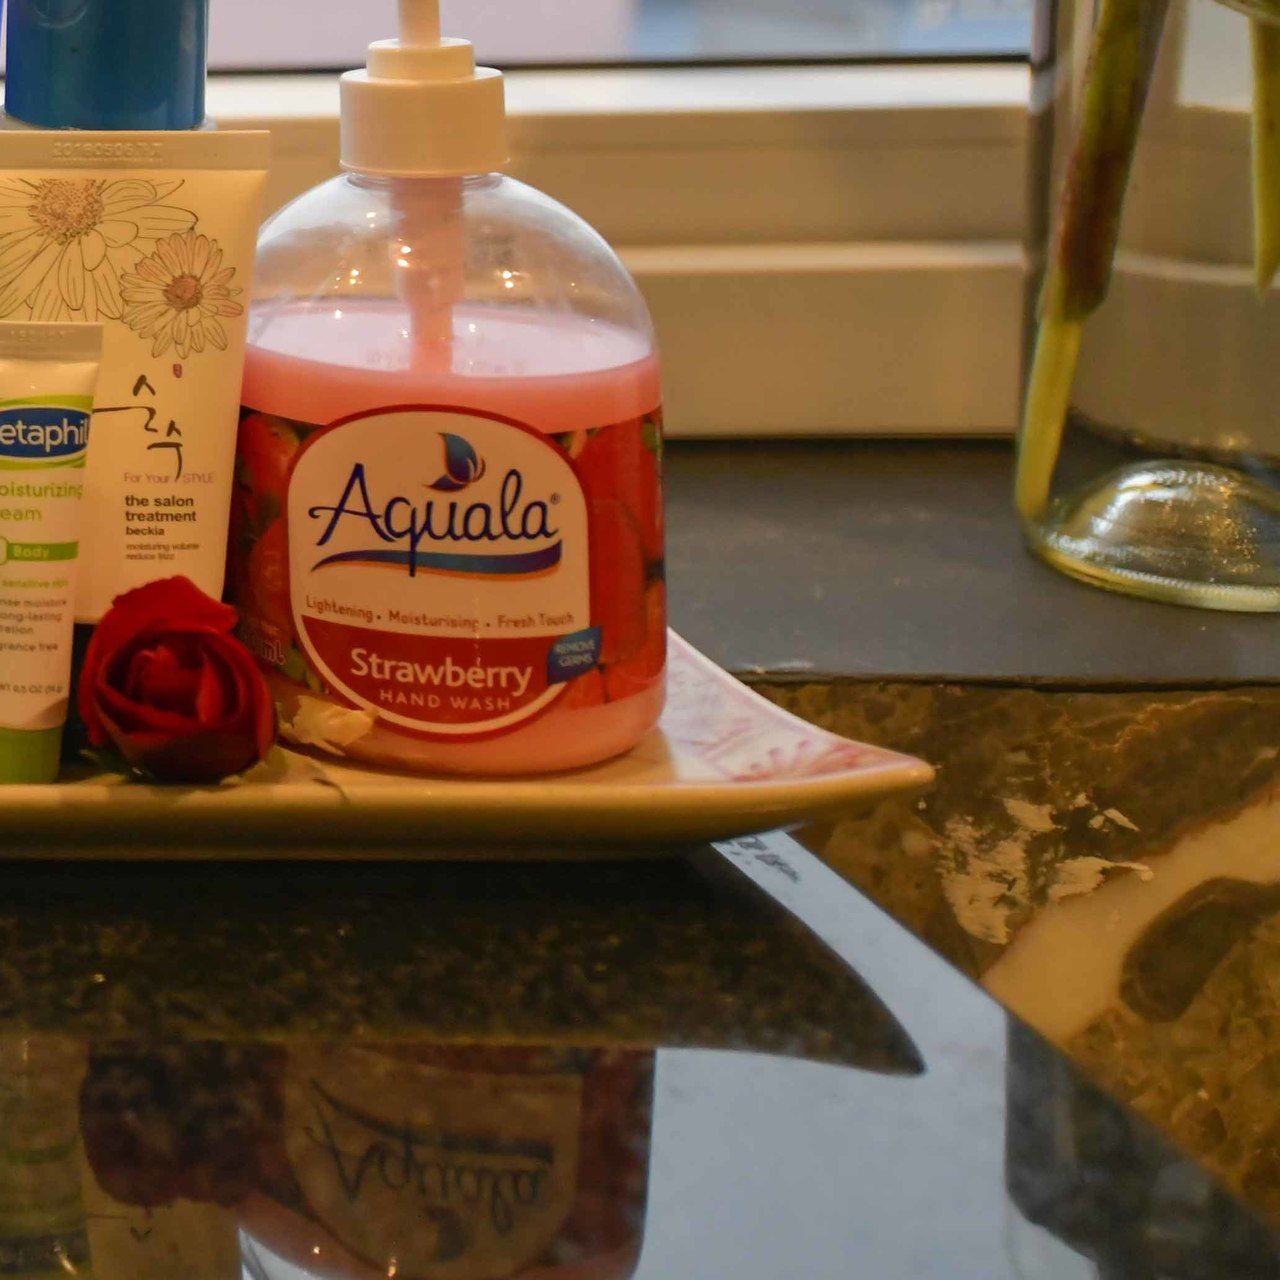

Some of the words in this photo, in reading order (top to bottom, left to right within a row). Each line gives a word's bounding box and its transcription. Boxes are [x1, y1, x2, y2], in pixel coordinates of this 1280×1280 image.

[183, 472, 215, 483] STYLE
[125, 495, 149, 507] the
[154, 495, 194, 507] salon
[125, 510, 197, 522] treatment
[308, 462, 559, 577] Aquala
[125, 525, 165, 536] beckia
[13, 545, 49, 558] Body
[306, 595, 374, 622] Lightening
[389, 609, 479, 631] Moisturising
[497, 614, 536, 628] Fresh
[540, 613, 574, 626] Touch
[39, 642, 58, 651] free
[350, 648, 533, 697] Strawberry
[379, 690, 441, 708] HAND
[450, 695, 511, 711] WASH
